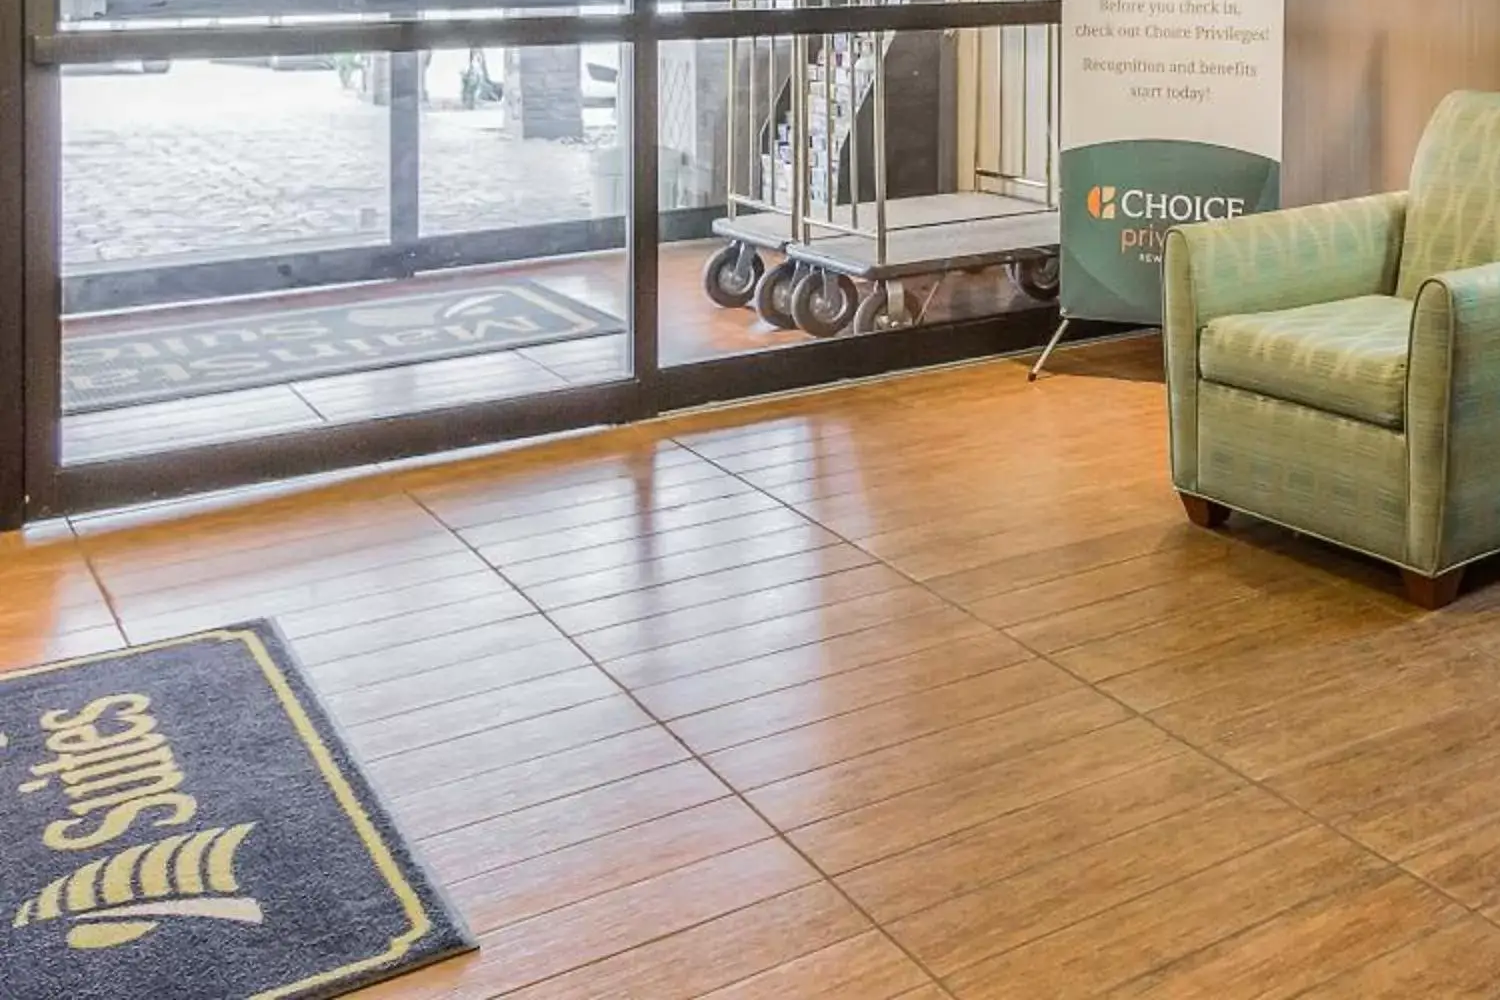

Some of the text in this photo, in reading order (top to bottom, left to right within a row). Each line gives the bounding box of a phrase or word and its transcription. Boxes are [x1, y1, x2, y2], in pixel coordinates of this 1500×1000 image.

[1149, 2, 1176, 18] you
[1178, 0, 1220, 15] check
[1075, 23, 1270, 45] check out Choice Privileges!
[1083, 57, 1257, 77] Recognition and benefits
[1130, 85, 1211, 104] start today!
[1121, 189, 1245, 221] CHOICE
[1121, 224, 1166, 253] priv
[66, 313, 542, 391] MainSta
[68, 318, 330, 364] Suite
[18, 693, 197, 850] Suites
